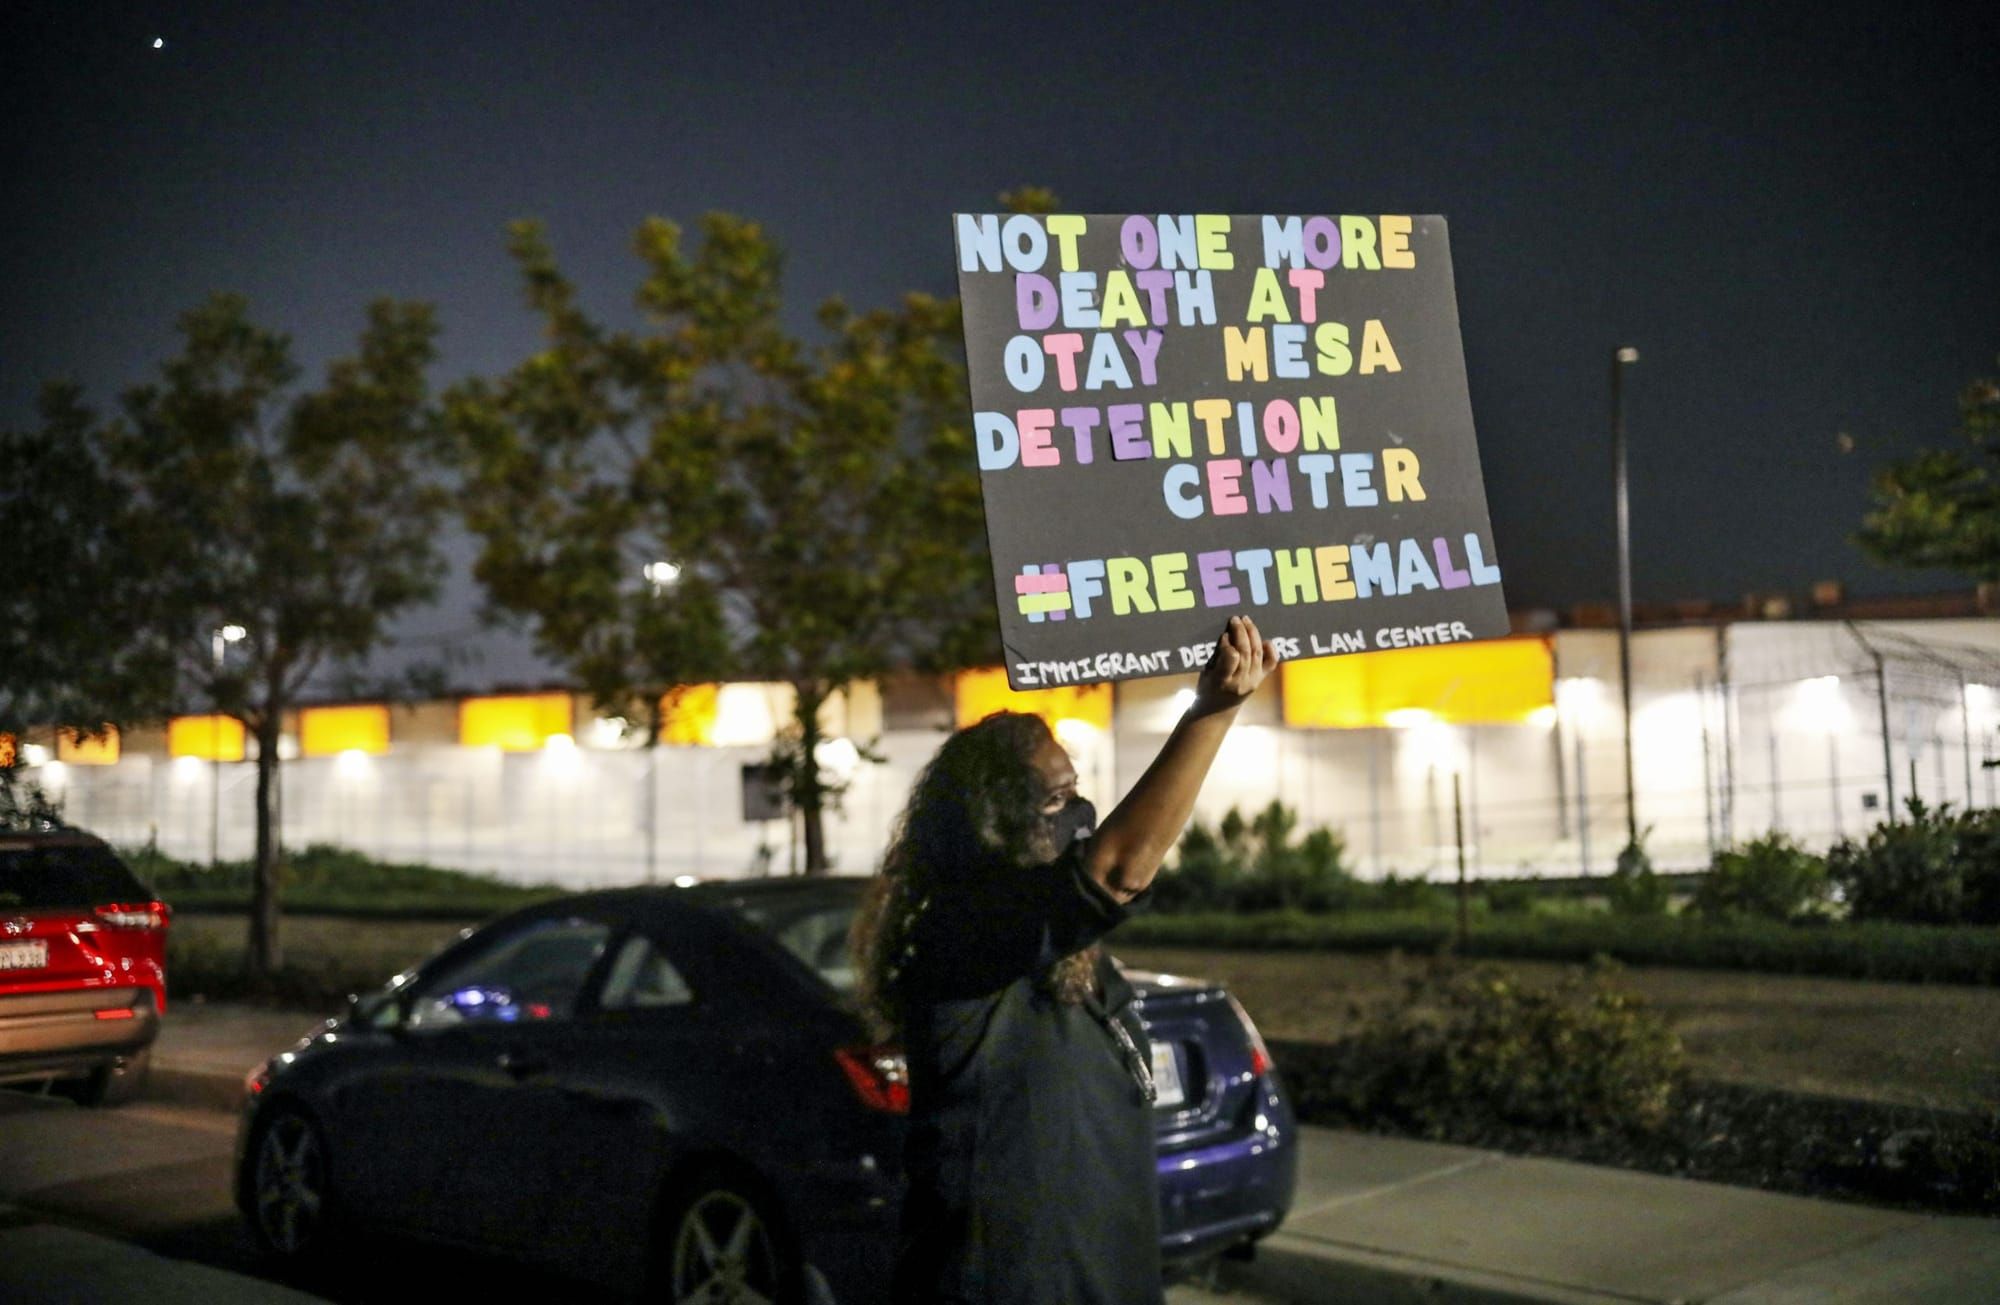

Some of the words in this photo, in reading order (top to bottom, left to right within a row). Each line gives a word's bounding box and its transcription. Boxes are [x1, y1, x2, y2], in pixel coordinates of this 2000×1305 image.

[957, 214, 1086, 272] NOT
[1120, 214, 1234, 270] ONE
[1262, 214, 1415, 270] MORE
[1016, 270, 1217, 331] DEATH
[1246, 268, 1325, 323] AT
[1003, 329, 1163, 392] OTAY
[1224, 320, 1401, 382] MESA
[974, 397, 1340, 470] DETENTION
[1163, 448, 1426, 519] CENTER
[1015, 533, 1501, 623] #FREETHEMALL
[1016, 650, 1171, 685] IMMIGRANT
[1180, 637, 1300, 668] DEFRS
[1310, 630, 1366, 656] LAW
[1376, 622, 1473, 649] CENTER
